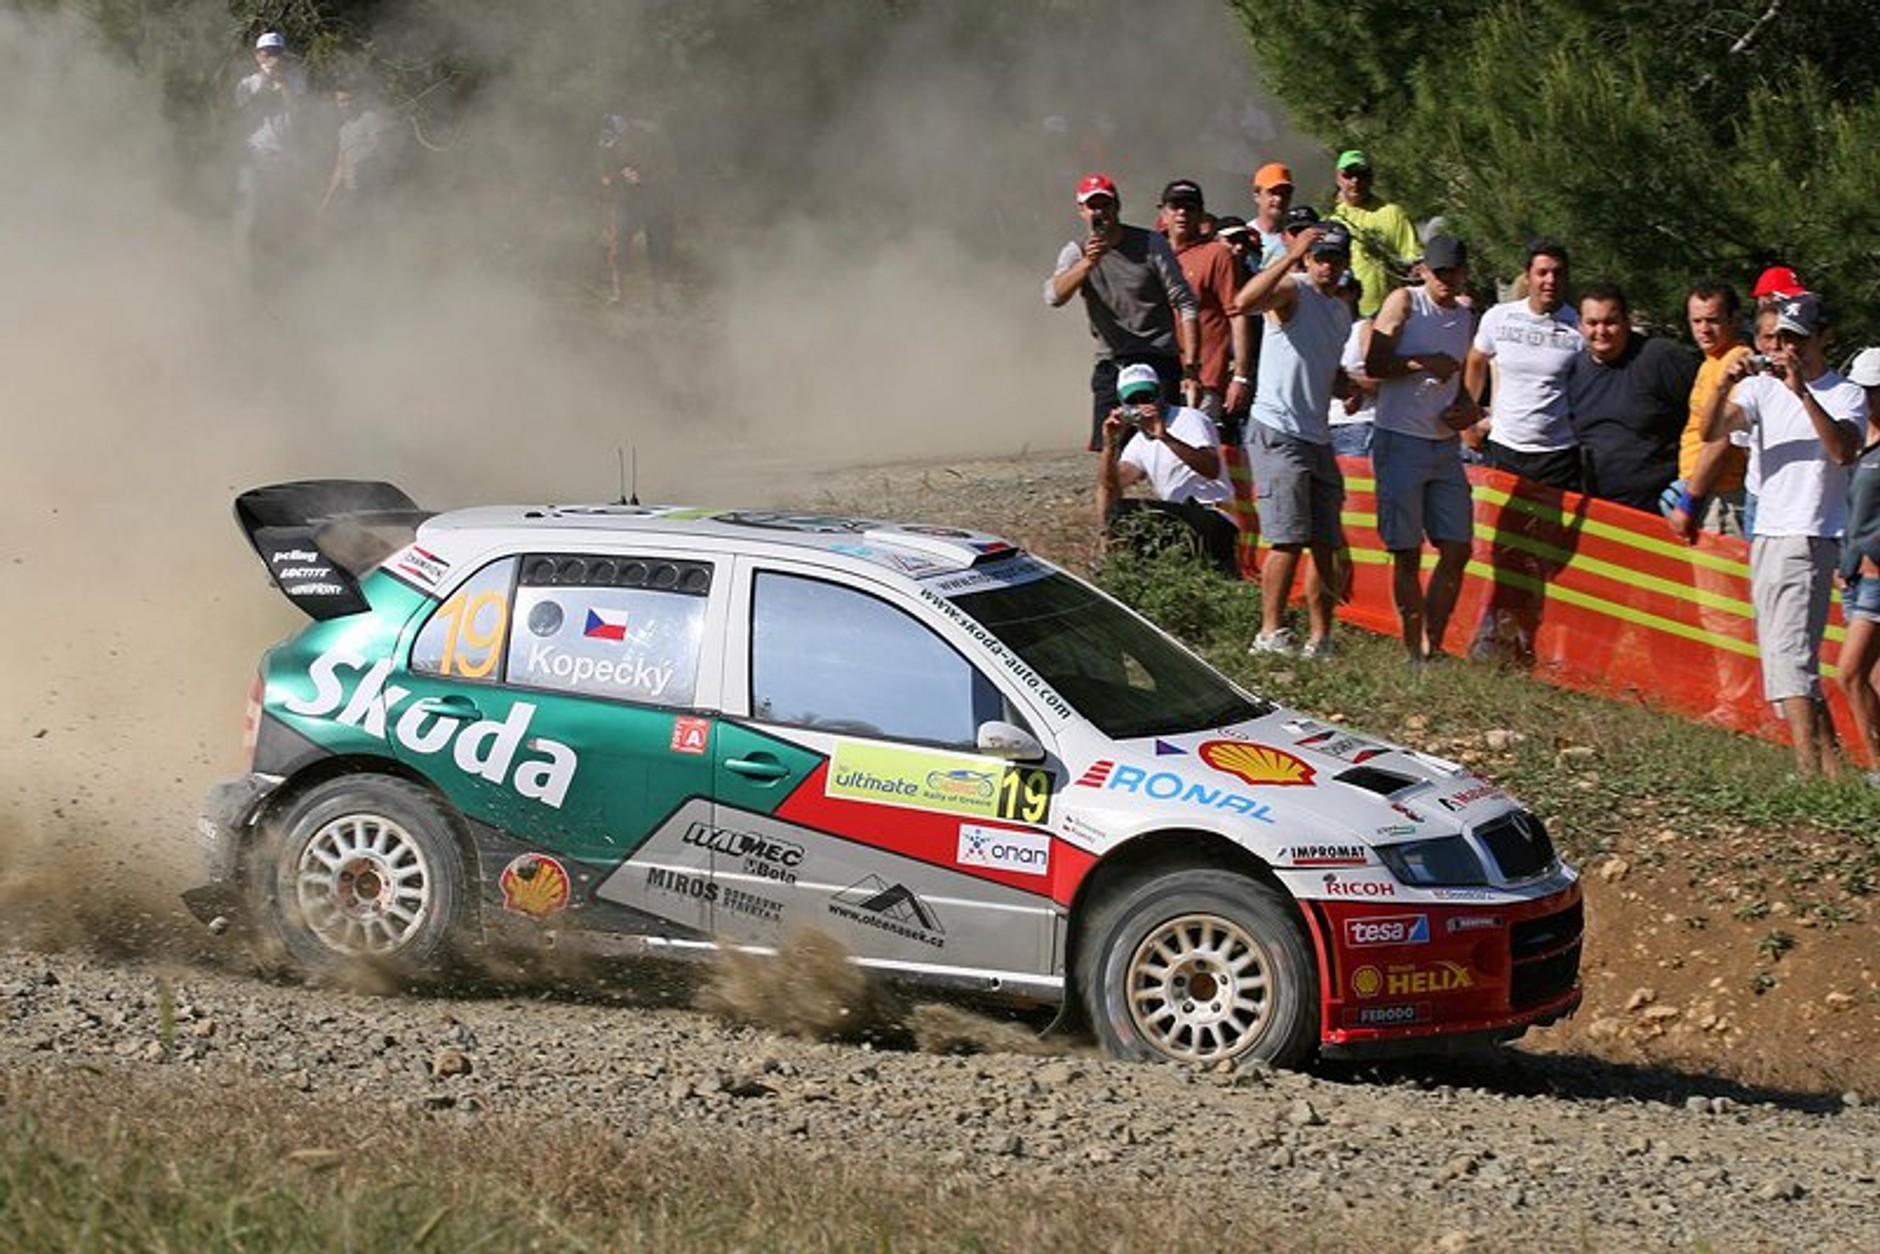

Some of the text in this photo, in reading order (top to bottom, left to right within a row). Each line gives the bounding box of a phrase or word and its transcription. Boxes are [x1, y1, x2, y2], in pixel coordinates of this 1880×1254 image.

[437, 591, 507, 677] 19
[920, 588, 1073, 719] www.skoda-auto.com
[835, 772, 919, 796] ultimate
[1003, 766, 1049, 823] 19
[1107, 764, 1276, 824] RONAL
[1290, 845, 1366, 858] IMPROMAT
[647, 866, 719, 902] MIROS
[1325, 882, 1395, 896] RICOH
[1350, 920, 1405, 943] tesa
[1386, 967, 1472, 995] HELIX
[1360, 1006, 1415, 1022] FERODO
